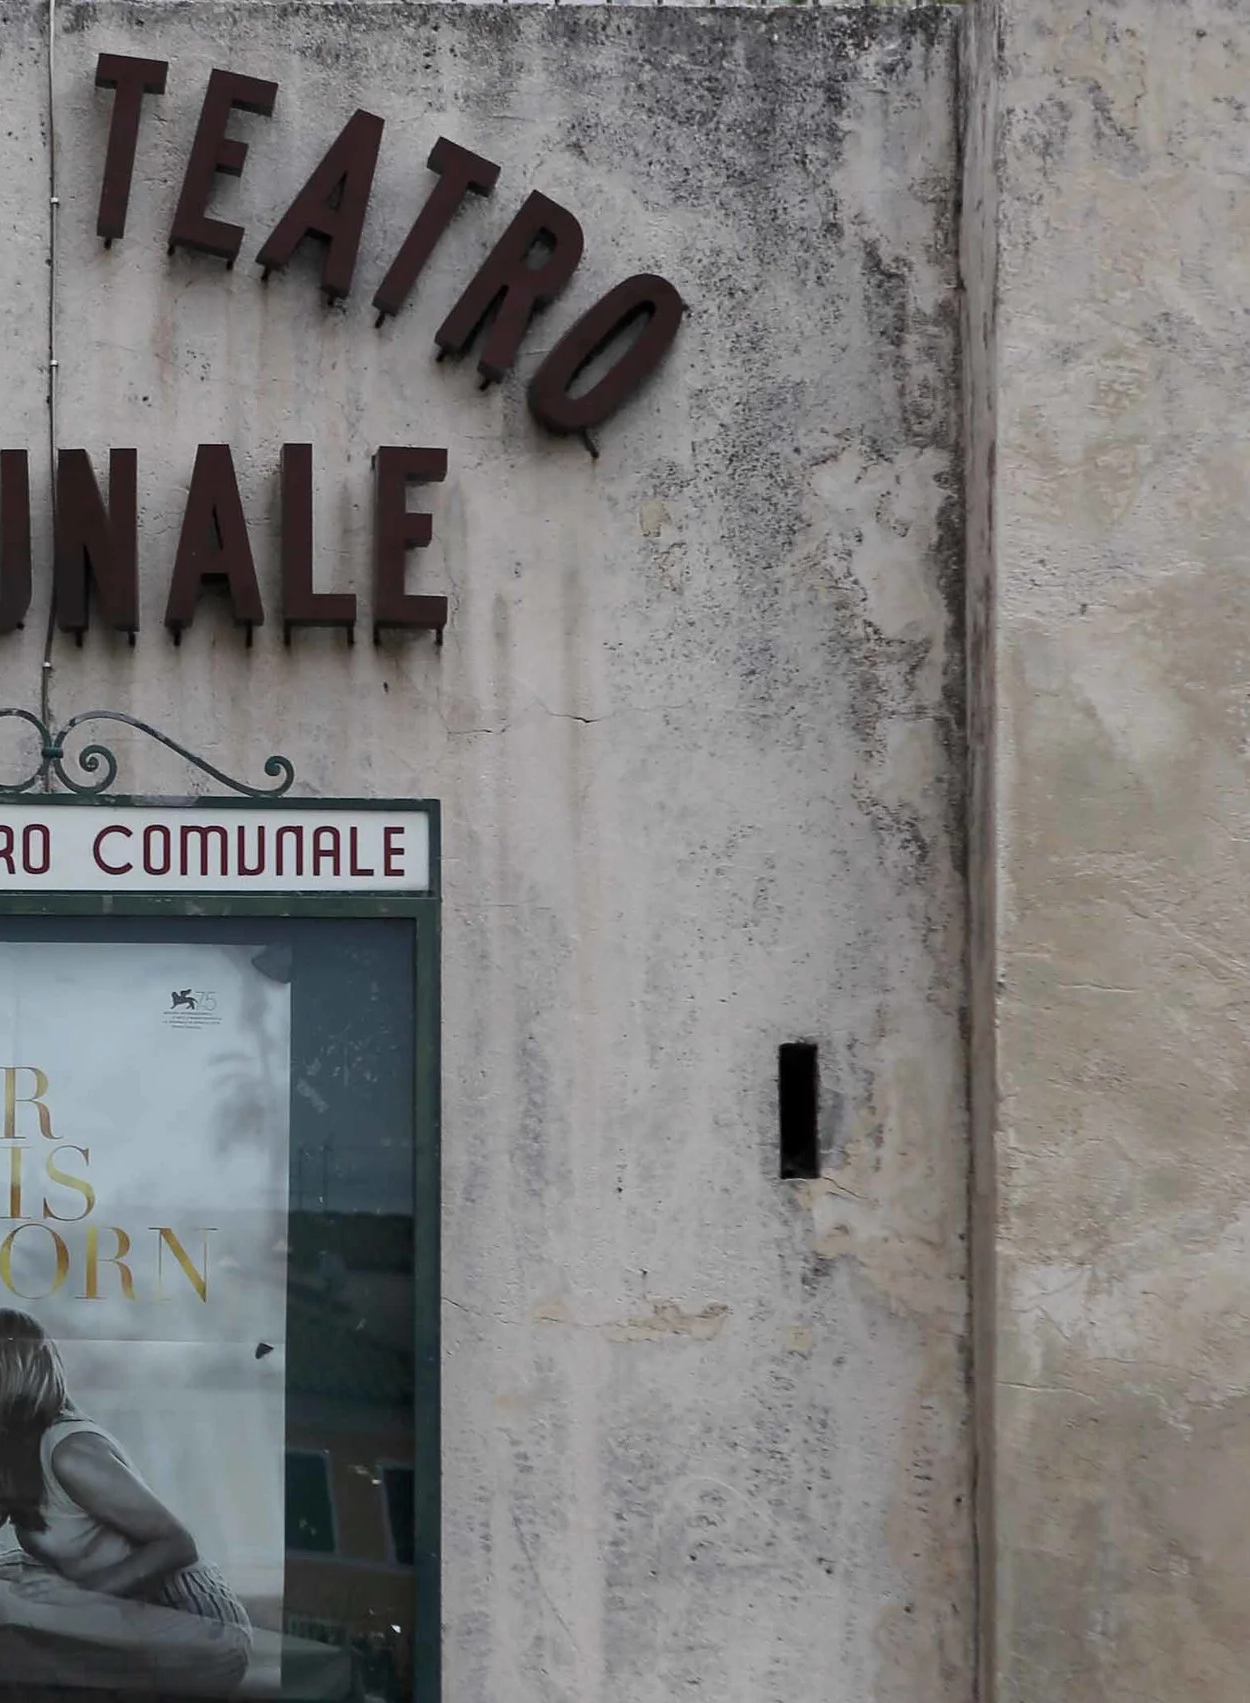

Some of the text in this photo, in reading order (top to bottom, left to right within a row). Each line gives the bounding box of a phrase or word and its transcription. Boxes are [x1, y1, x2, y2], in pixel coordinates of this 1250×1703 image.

[95, 52, 685, 437] TEATRO
[92, 824, 405, 877] COMUNALE
[0, 1144, 96, 1221] IS
